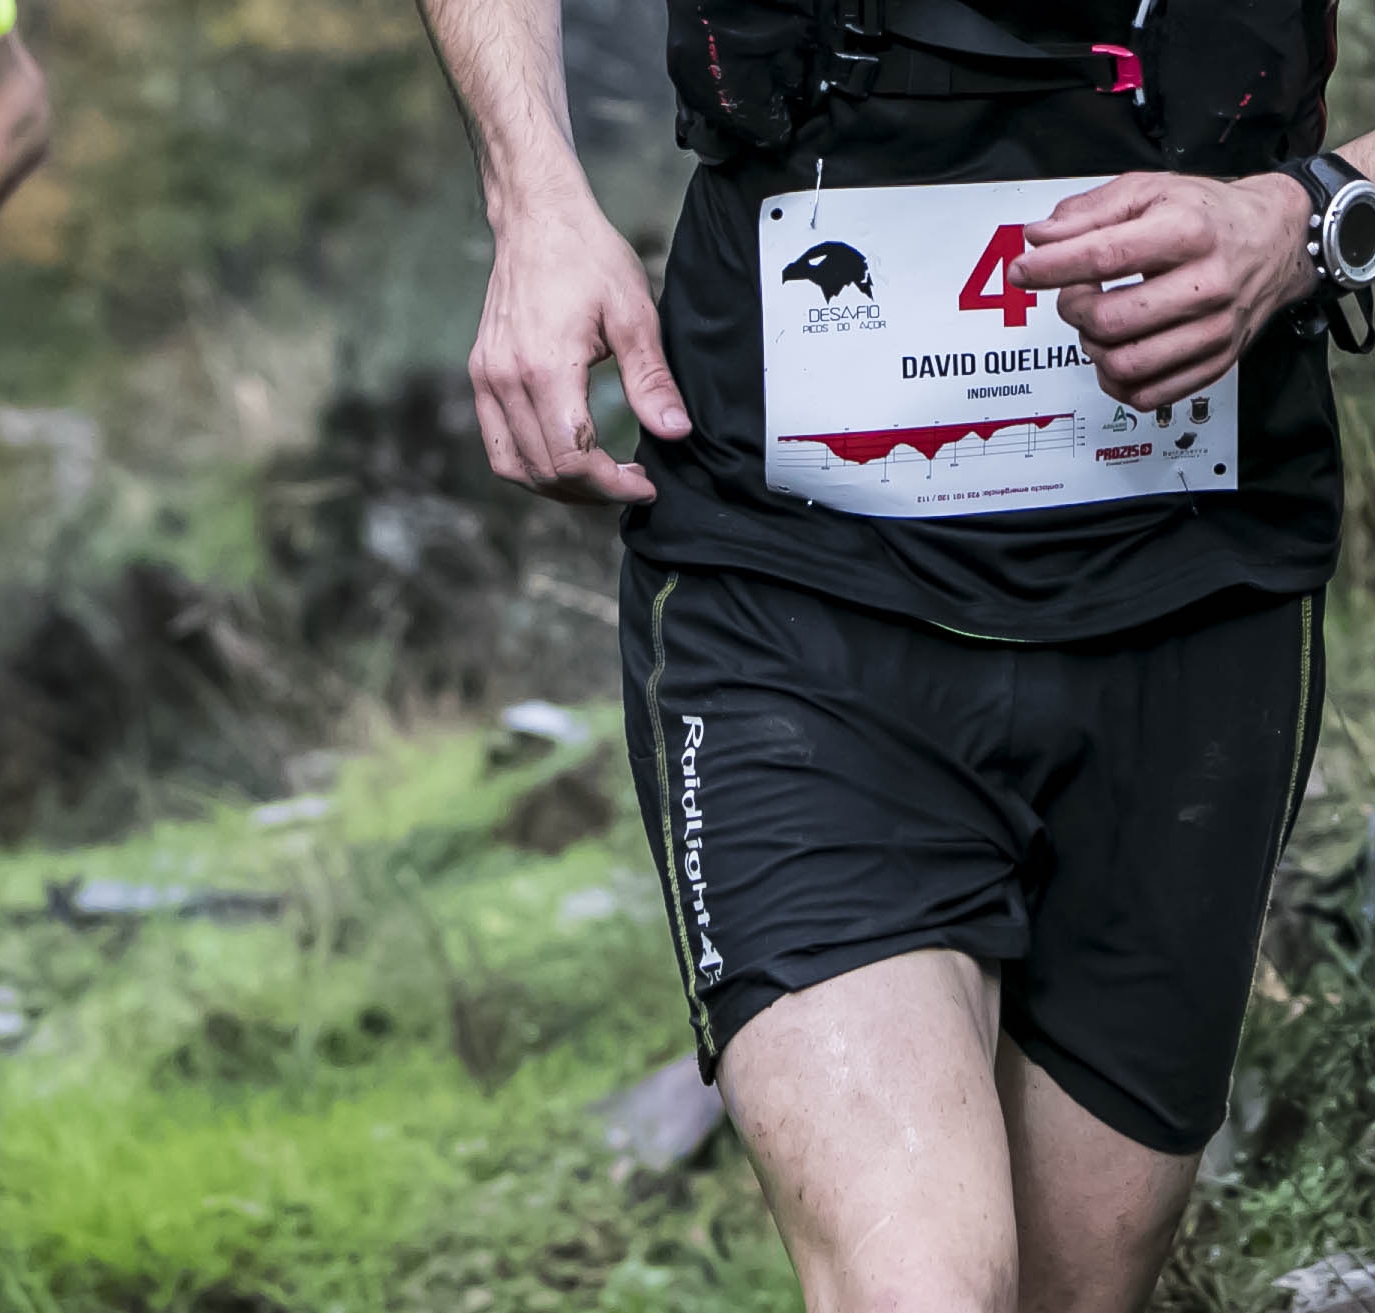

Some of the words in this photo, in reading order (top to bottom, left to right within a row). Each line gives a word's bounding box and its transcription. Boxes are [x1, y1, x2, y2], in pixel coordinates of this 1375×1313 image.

[958, 224, 1038, 328] 4
[808, 304, 880, 323] DESAFIO
[802, 324, 829, 334] PICOS
[836, 322, 851, 332] DO
[901, 353, 976, 379] DAVID
[967, 383, 1033, 400] INDIVIDUAL
[1095, 444, 1140, 462] PROZIS
